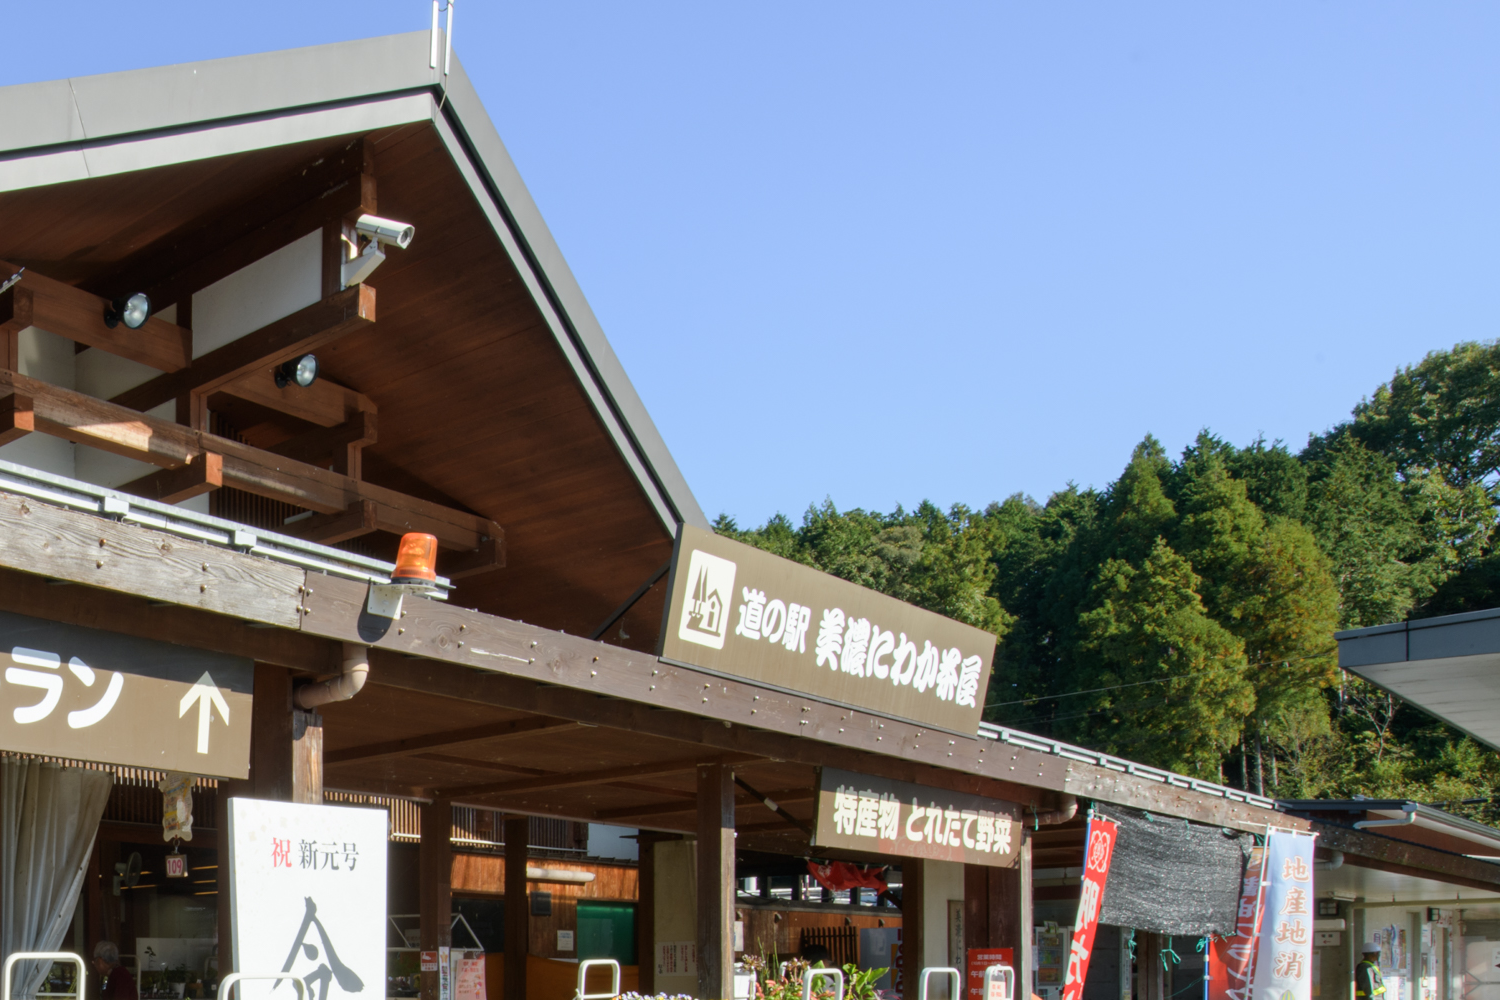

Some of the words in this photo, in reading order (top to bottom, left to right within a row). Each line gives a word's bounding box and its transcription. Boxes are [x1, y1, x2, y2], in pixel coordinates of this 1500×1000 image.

[735, 586, 811, 654] 道の駅
[815, 607, 982, 708] 美濃にわか茶屋
[271, 837, 292, 867] 祝
[298, 839, 359, 871] 新元号
[833, 784, 900, 840] 特産物
[906, 797, 1014, 854] とれたて野菜
[167, 859, 183, 874] 109
[1273, 855, 1311, 980] 地産地消
